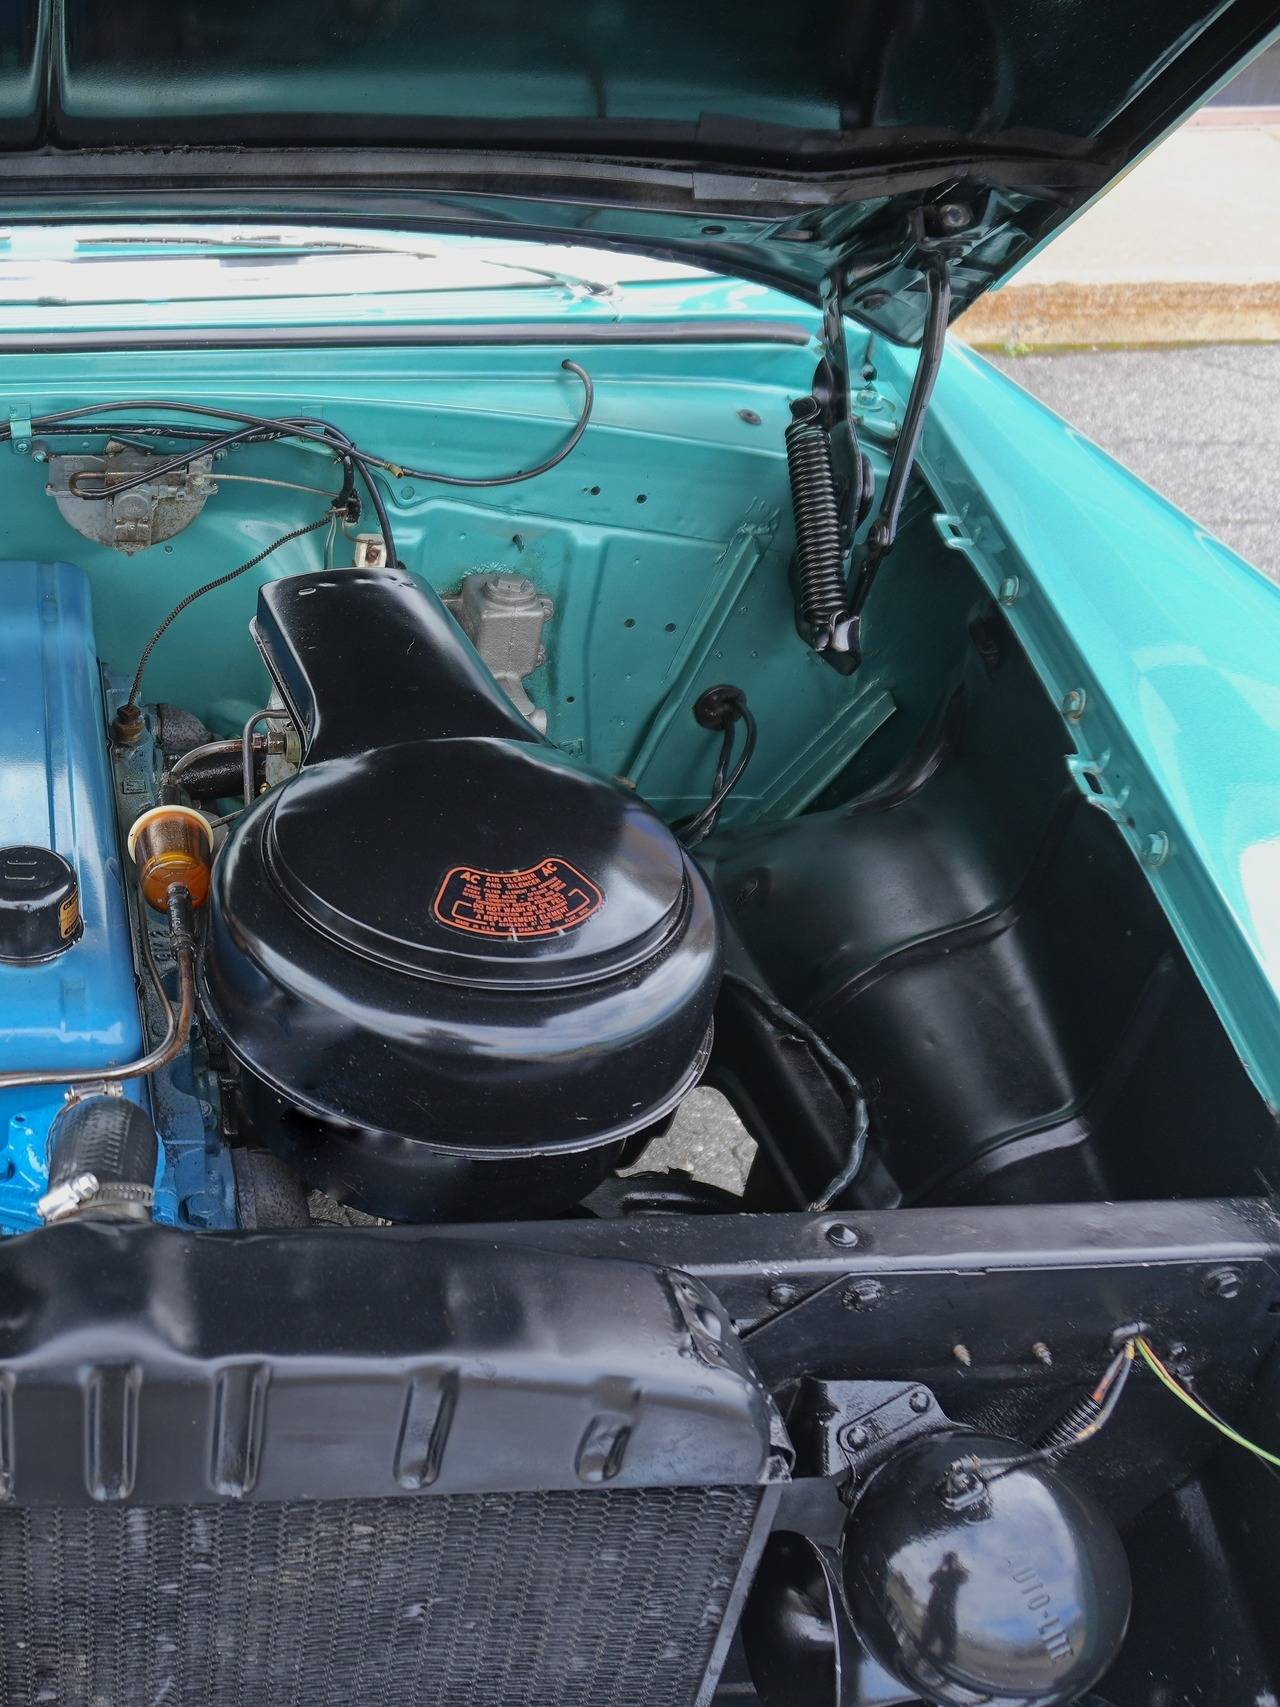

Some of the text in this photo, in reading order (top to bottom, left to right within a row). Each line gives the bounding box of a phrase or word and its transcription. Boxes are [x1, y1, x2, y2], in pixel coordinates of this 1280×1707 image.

[542, 863, 558, 876] AC
[460, 872, 481, 884] AC
[503, 873, 537, 883] CLEANER
[506, 878, 541, 889] SILENCER
[473, 902, 485, 910] DO
[483, 914, 538, 922] REPLACEMENT
[539, 906, 569, 920] ELEMENT
